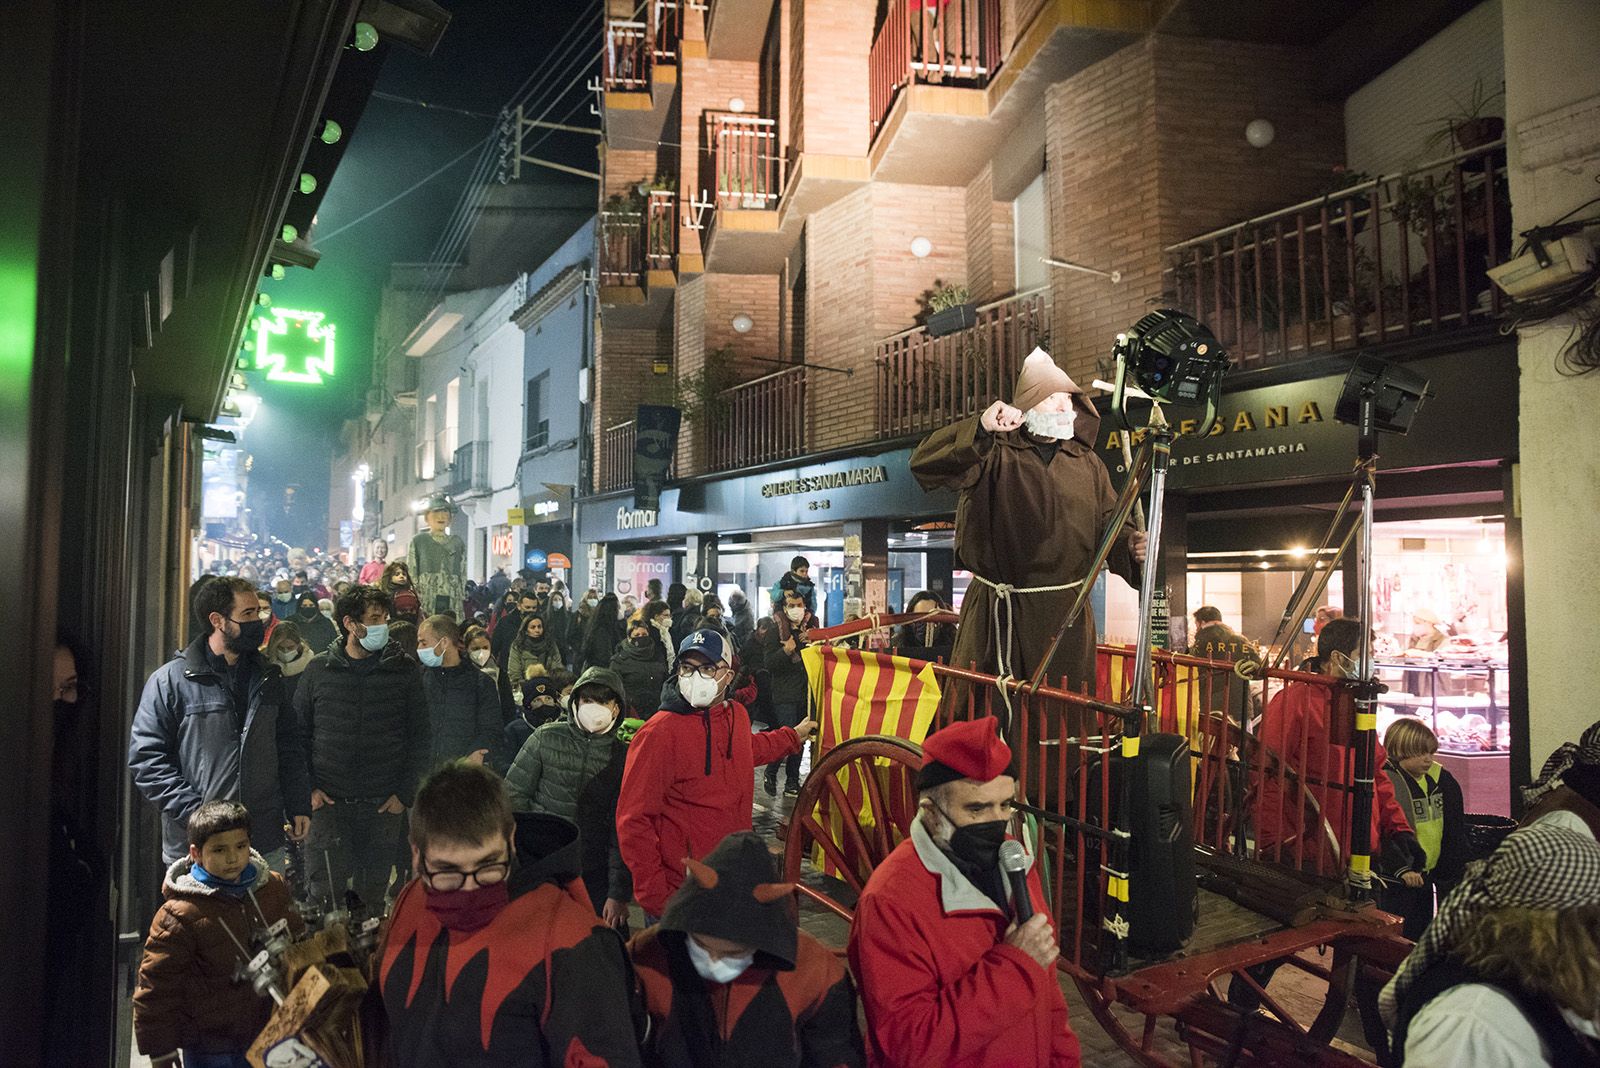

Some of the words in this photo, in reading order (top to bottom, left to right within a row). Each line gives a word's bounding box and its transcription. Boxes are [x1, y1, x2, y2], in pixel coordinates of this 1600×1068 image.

[1105, 401, 1322, 450] ARESANA
[1183, 455, 1201, 465] DE
[1206, 442, 1305, 463] SANTAMARIA
[762, 477, 810, 497] GALERIES
[809, 471, 844, 491] SANTA
[846, 465, 885, 486] MARIA
[617, 506, 657, 530] flormar
[693, 631, 705, 644] LA
